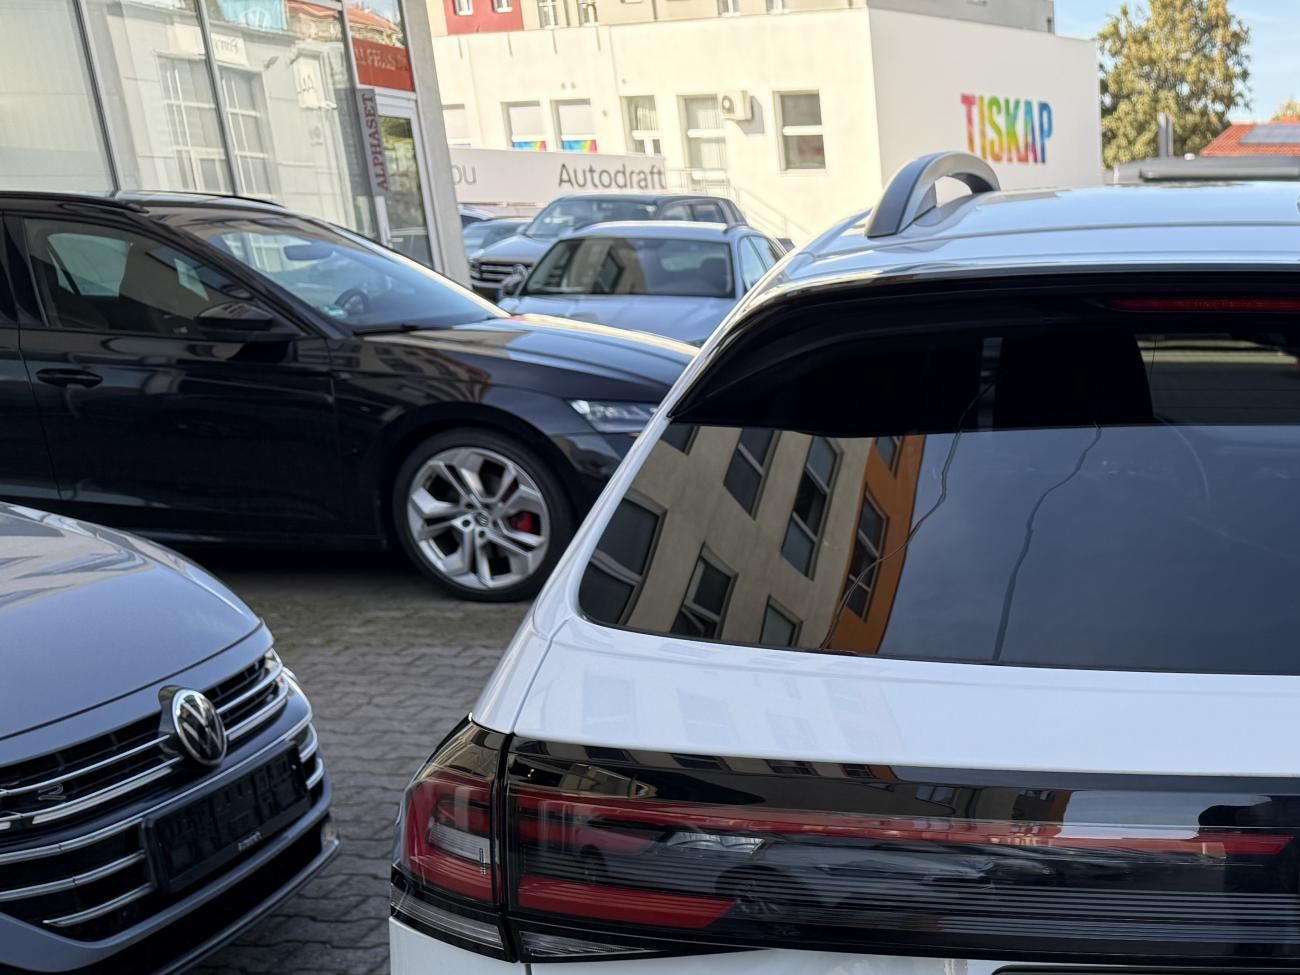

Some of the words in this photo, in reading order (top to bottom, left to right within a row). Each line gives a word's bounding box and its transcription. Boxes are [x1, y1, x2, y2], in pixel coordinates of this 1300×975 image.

[362, 93, 389, 192] ALPHASET
[961, 94, 1053, 164] TISKAP
[558, 162, 667, 190] Autodraft
